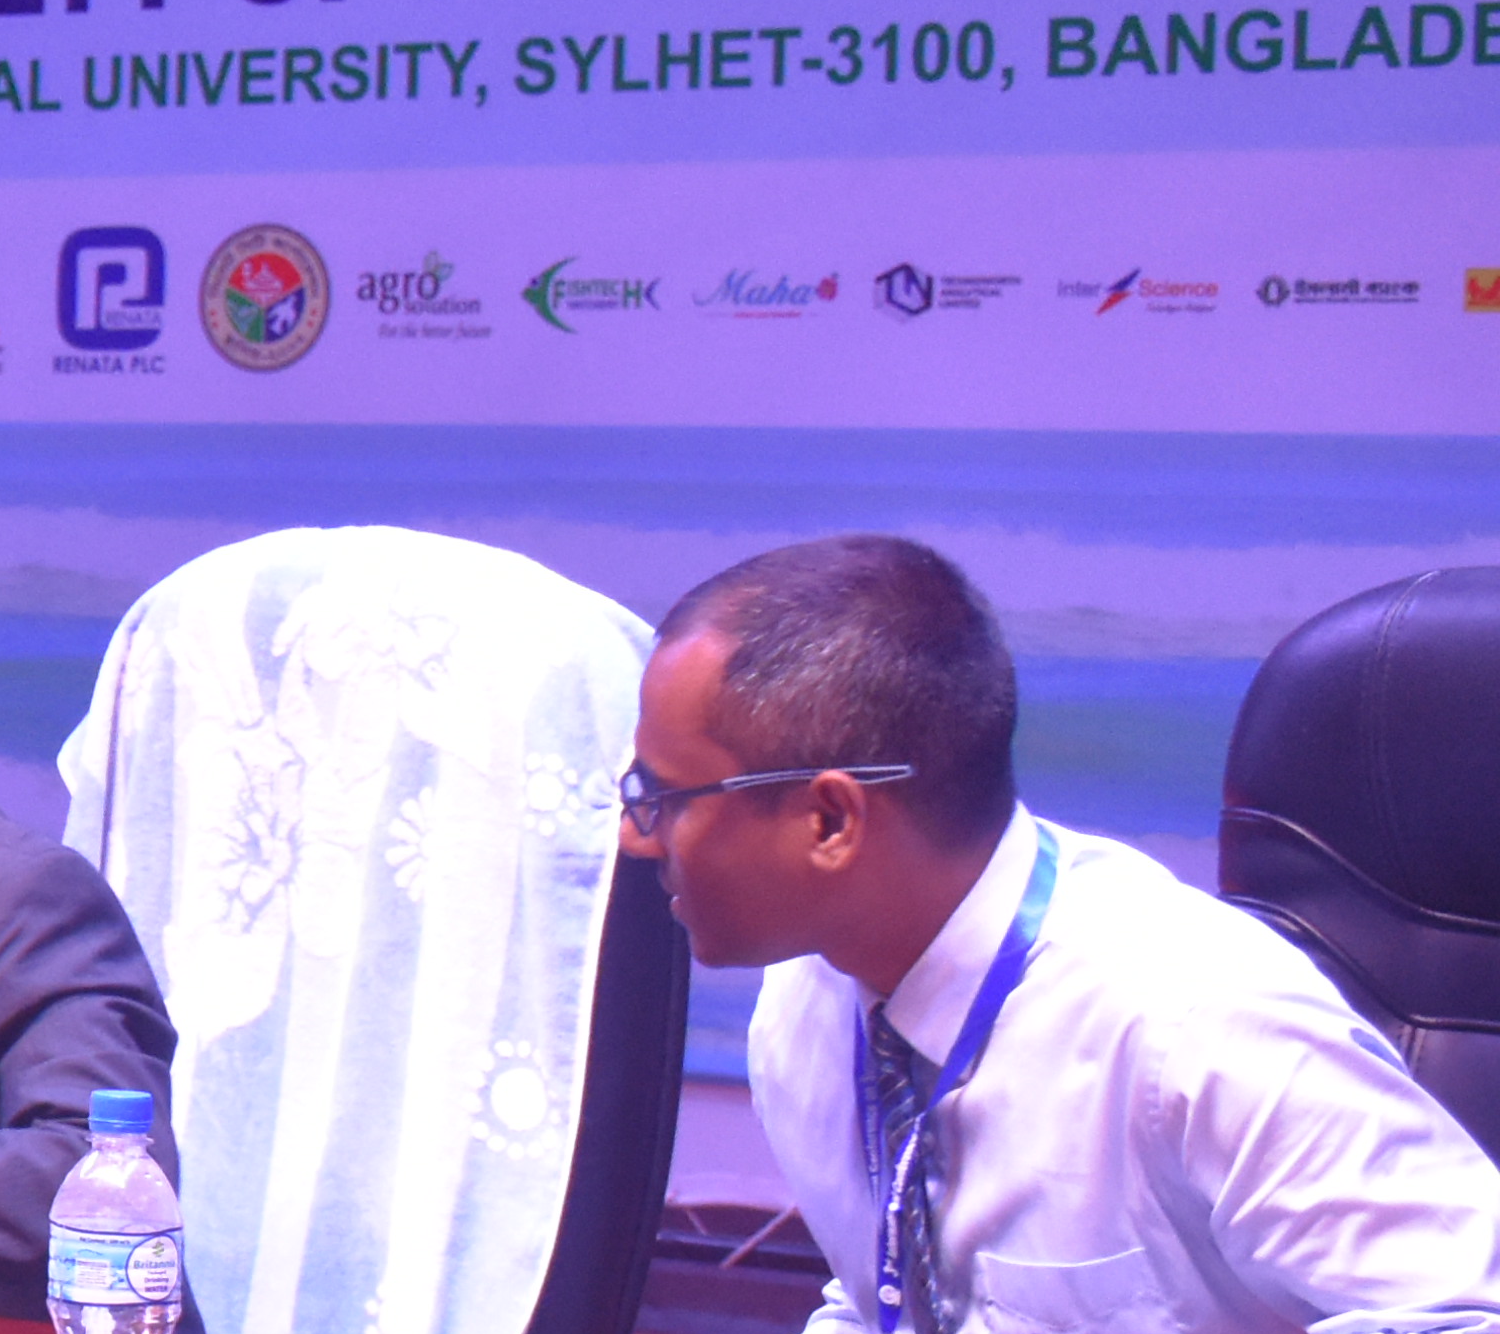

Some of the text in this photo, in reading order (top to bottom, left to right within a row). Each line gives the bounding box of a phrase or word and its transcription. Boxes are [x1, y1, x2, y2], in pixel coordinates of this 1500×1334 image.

[84, 38, 488, 112] UNIVERSITY,
[513, 17, 1018, 95] SYLHET-3100,
[1046, 1, 1500, 79] BANGLADE
[356, 269, 441, 314] agro
[693, 267, 817, 307] Maha
[1137, 278, 1220, 300] Science
[404, 295, 482, 316] solution
[52, 356, 165, 374] RENATA PLC
